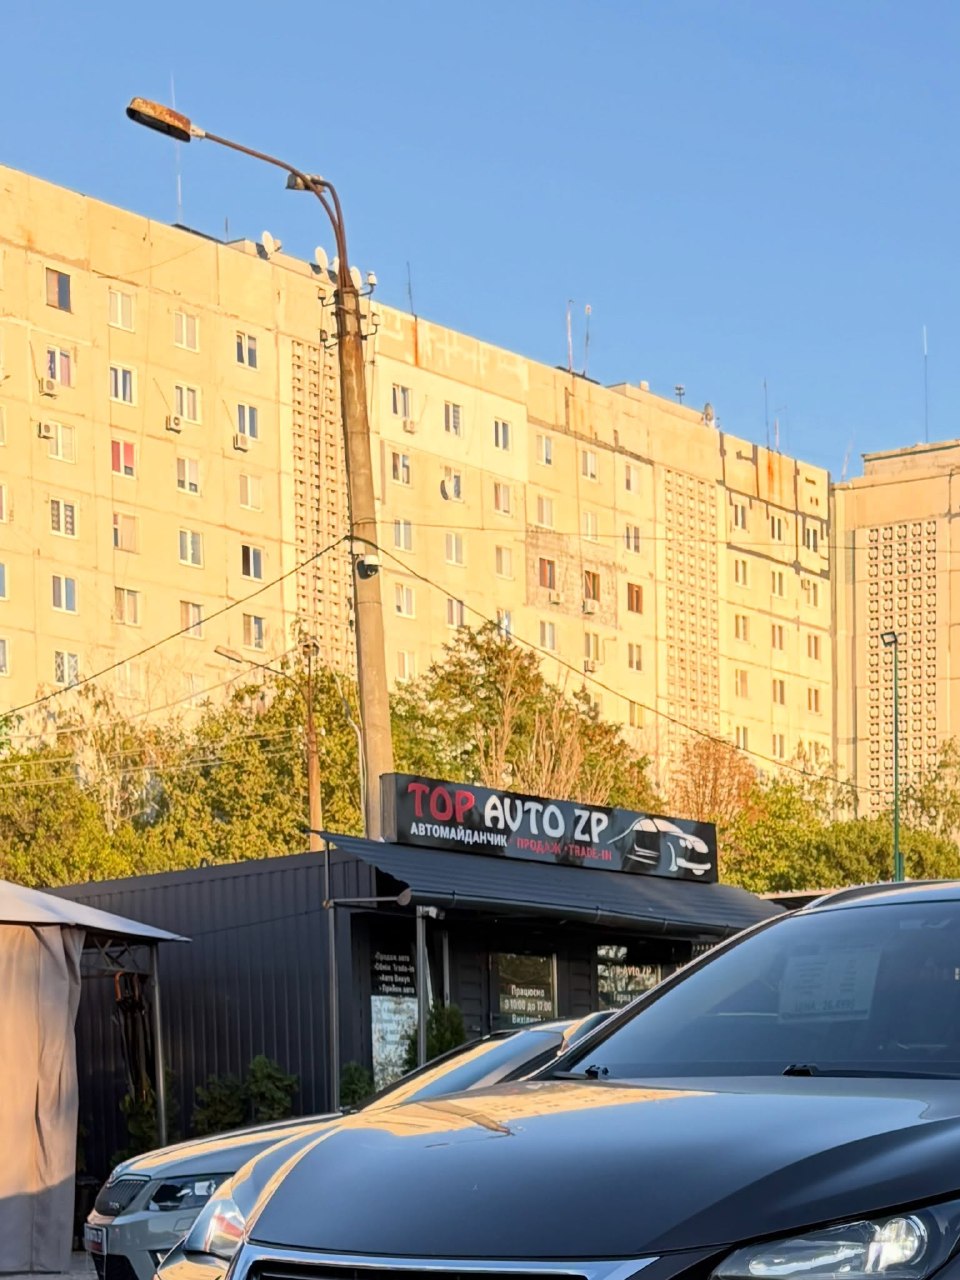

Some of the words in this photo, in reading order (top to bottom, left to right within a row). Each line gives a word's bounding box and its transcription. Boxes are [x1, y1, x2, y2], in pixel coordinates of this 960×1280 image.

[408, 782, 475, 823] TOP
[574, 808, 609, 844] ZP
[410, 822, 508, 848] АВТОМАЙДАНЧИК
[516, 837, 561, 855] ПРОДАЖ
[567, 844, 612, 861] TRADE-IN
